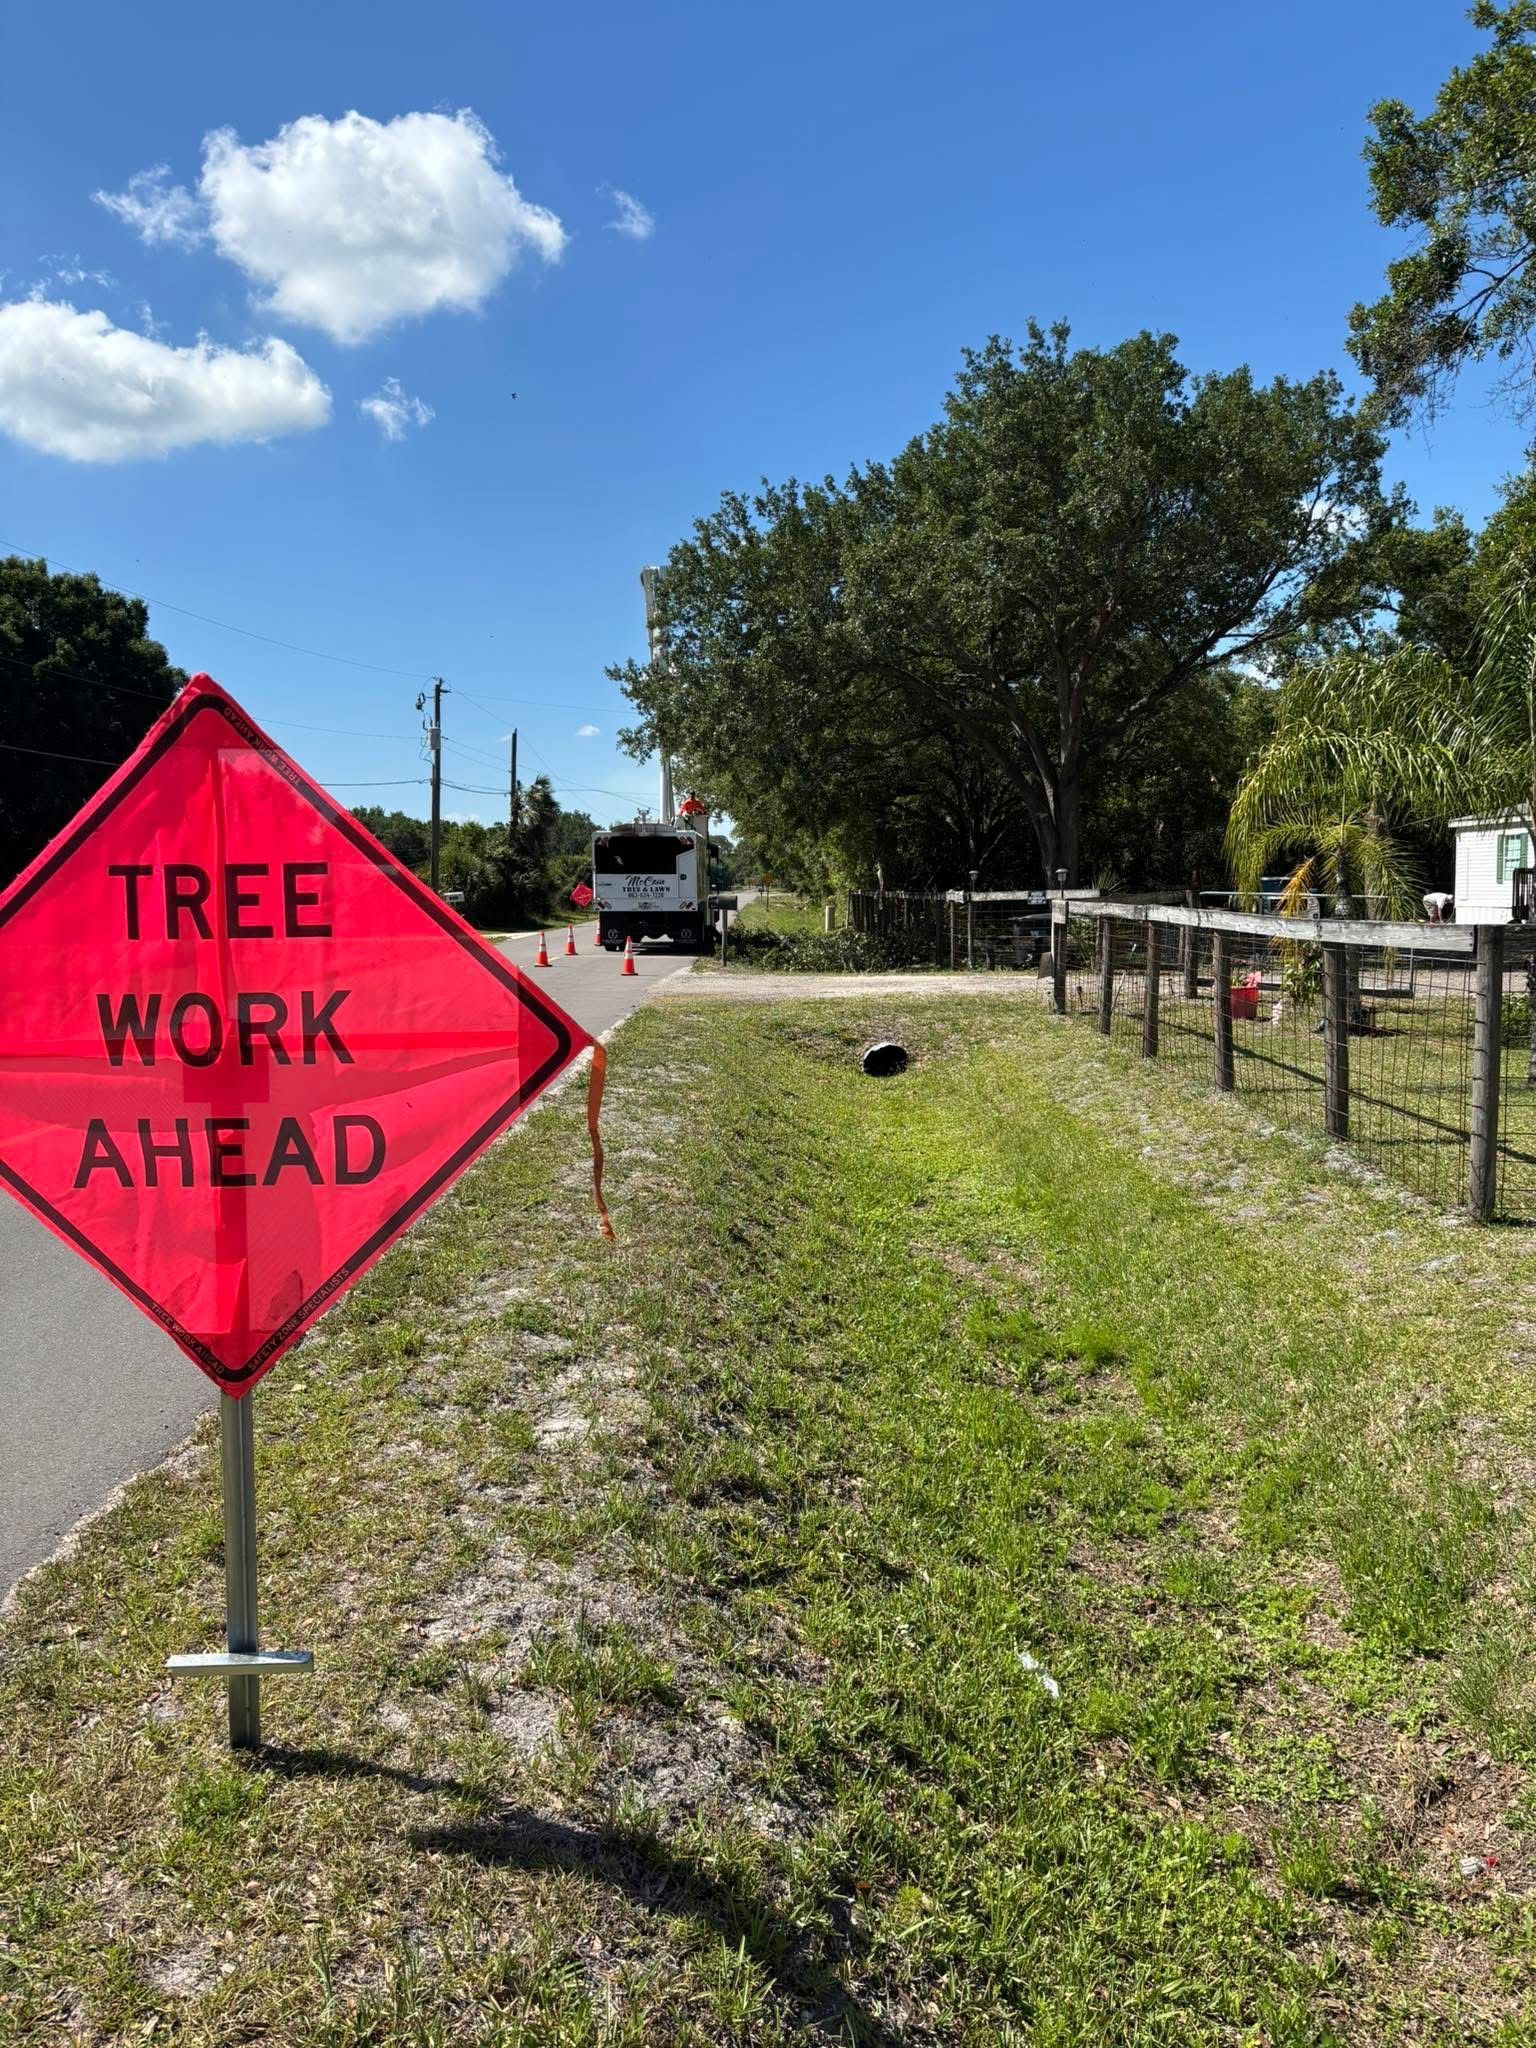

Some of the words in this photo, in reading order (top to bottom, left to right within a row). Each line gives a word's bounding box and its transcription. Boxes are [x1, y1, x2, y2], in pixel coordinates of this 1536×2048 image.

[223, 707, 255, 738] AHEAD
[254, 736, 278, 763] WORK
[278, 762, 300, 785] TREE
[108, 862, 334, 942] TREE
[97, 990, 354, 1068] WORK
[74, 1115, 386, 1189] AHEAD
[151, 1303, 173, 1327] TREE
[172, 1324, 195, 1348] WORK
[194, 1344, 225, 1375] AHEAD
[248, 1340, 278, 1371] SAFETY
[276, 1319, 300, 1342] ZONE
[297, 1267, 351, 1322] SPECIALISTS
